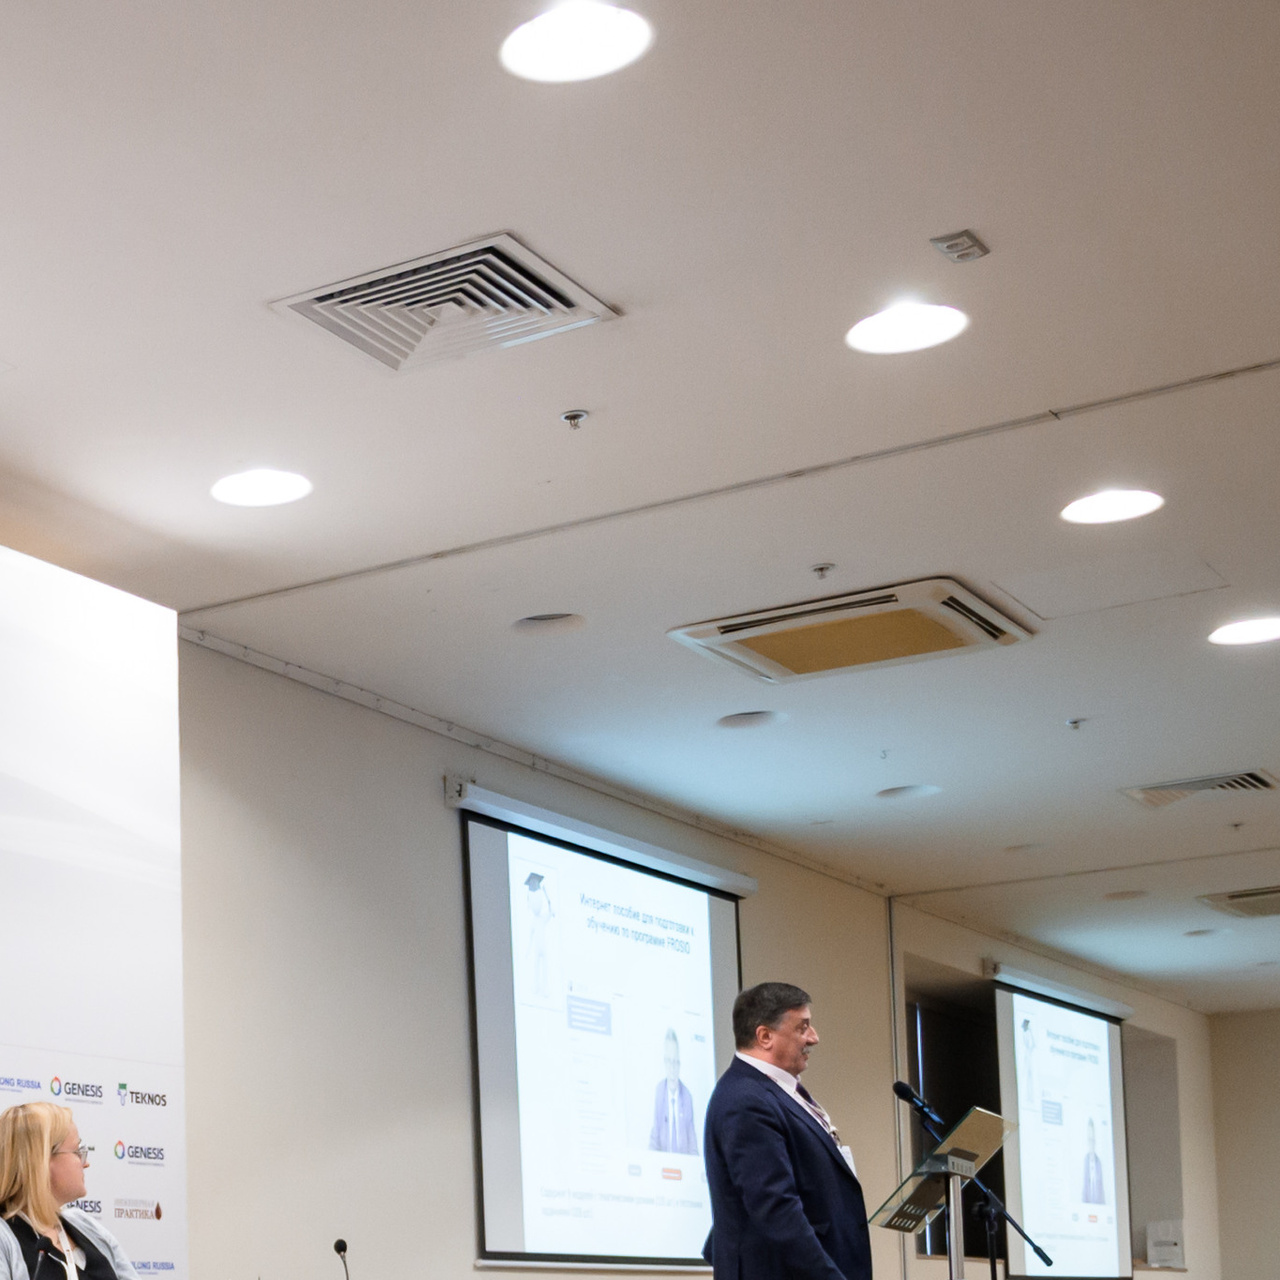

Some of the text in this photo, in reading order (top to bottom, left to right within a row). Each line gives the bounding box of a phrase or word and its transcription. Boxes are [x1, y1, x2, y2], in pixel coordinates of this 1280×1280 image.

[16, 1079, 41, 1089] RUSSIA
[64, 1082, 103, 1098] GENESIS
[129, 1091, 167, 1107] TEKNOS
[127, 1145, 164, 1160] GENESIS
[114, 1208, 155, 1220] ПРАКТИКА
